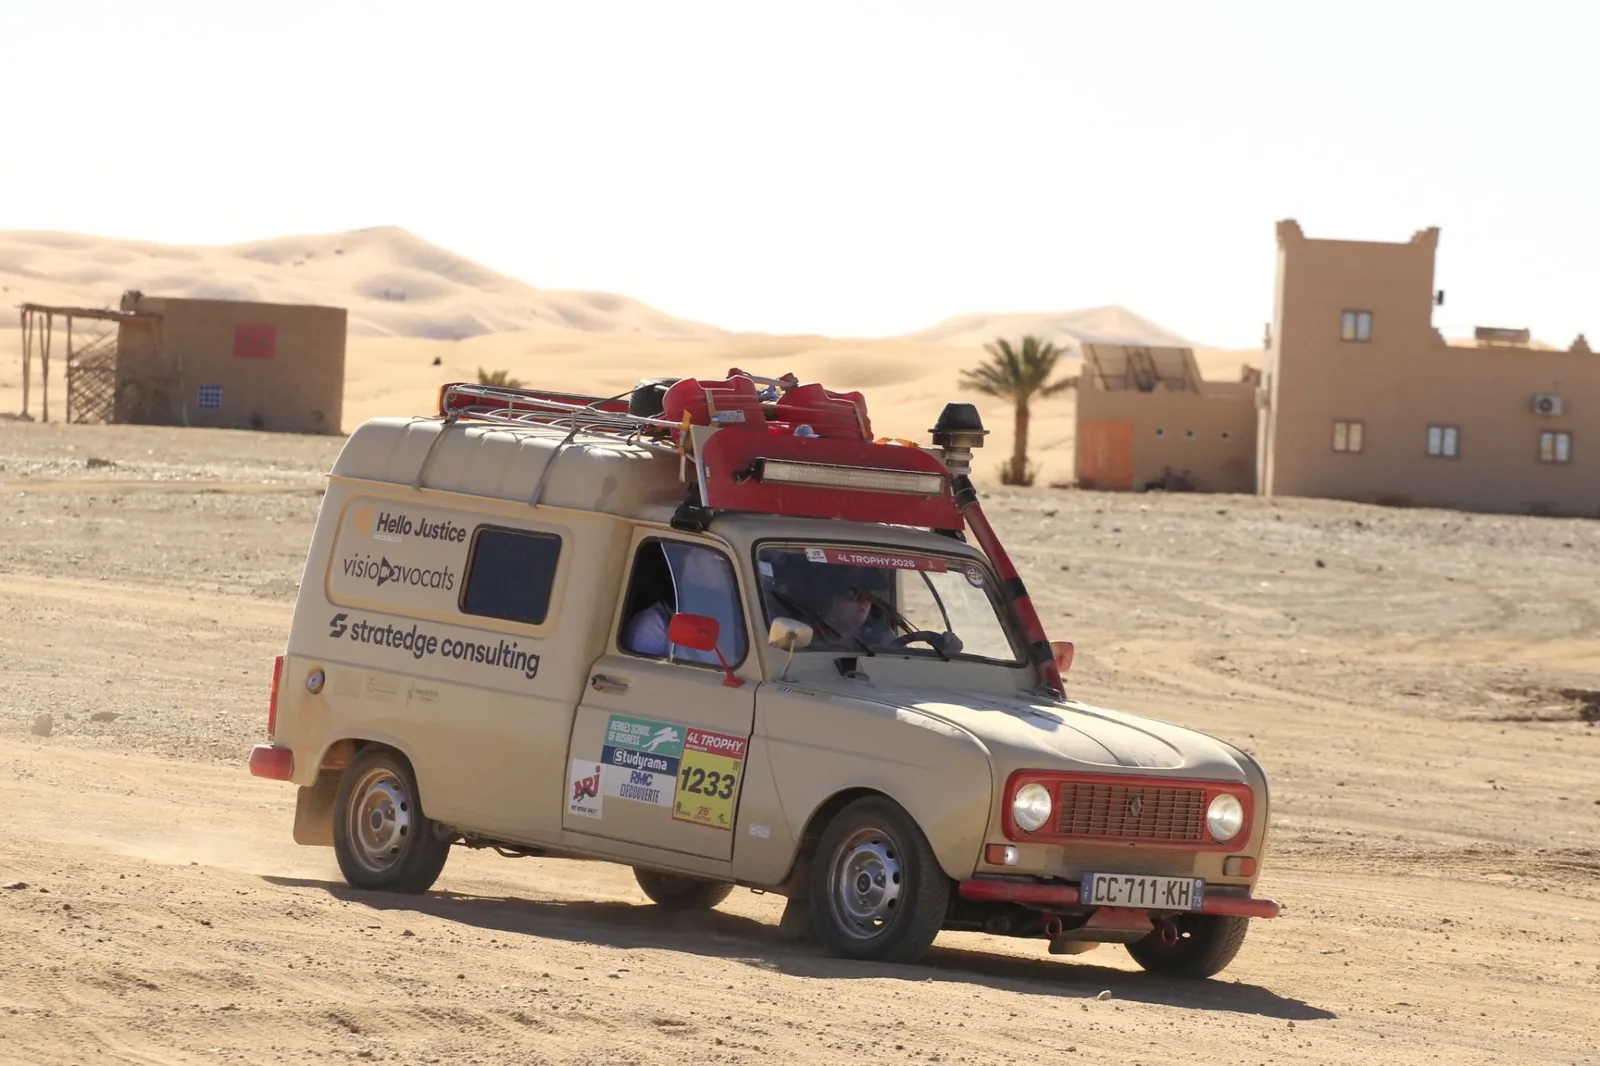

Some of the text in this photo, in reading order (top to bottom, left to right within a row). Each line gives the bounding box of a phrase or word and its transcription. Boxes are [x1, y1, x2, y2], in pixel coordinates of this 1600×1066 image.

[376, 512, 467, 543] Hello Justice
[837, 553, 850, 562] 4L
[851, 555, 890, 566] TROPHY
[891, 558, 915, 568] 2026
[350, 620, 541, 680] stratedge consulting
[687, 732, 699, 744] 4L
[700, 734, 744, 752] TROPHY
[614, 750, 668, 770] Studyrama
[630, 770, 653, 787] RMC
[680, 766, 736, 800] 1233
